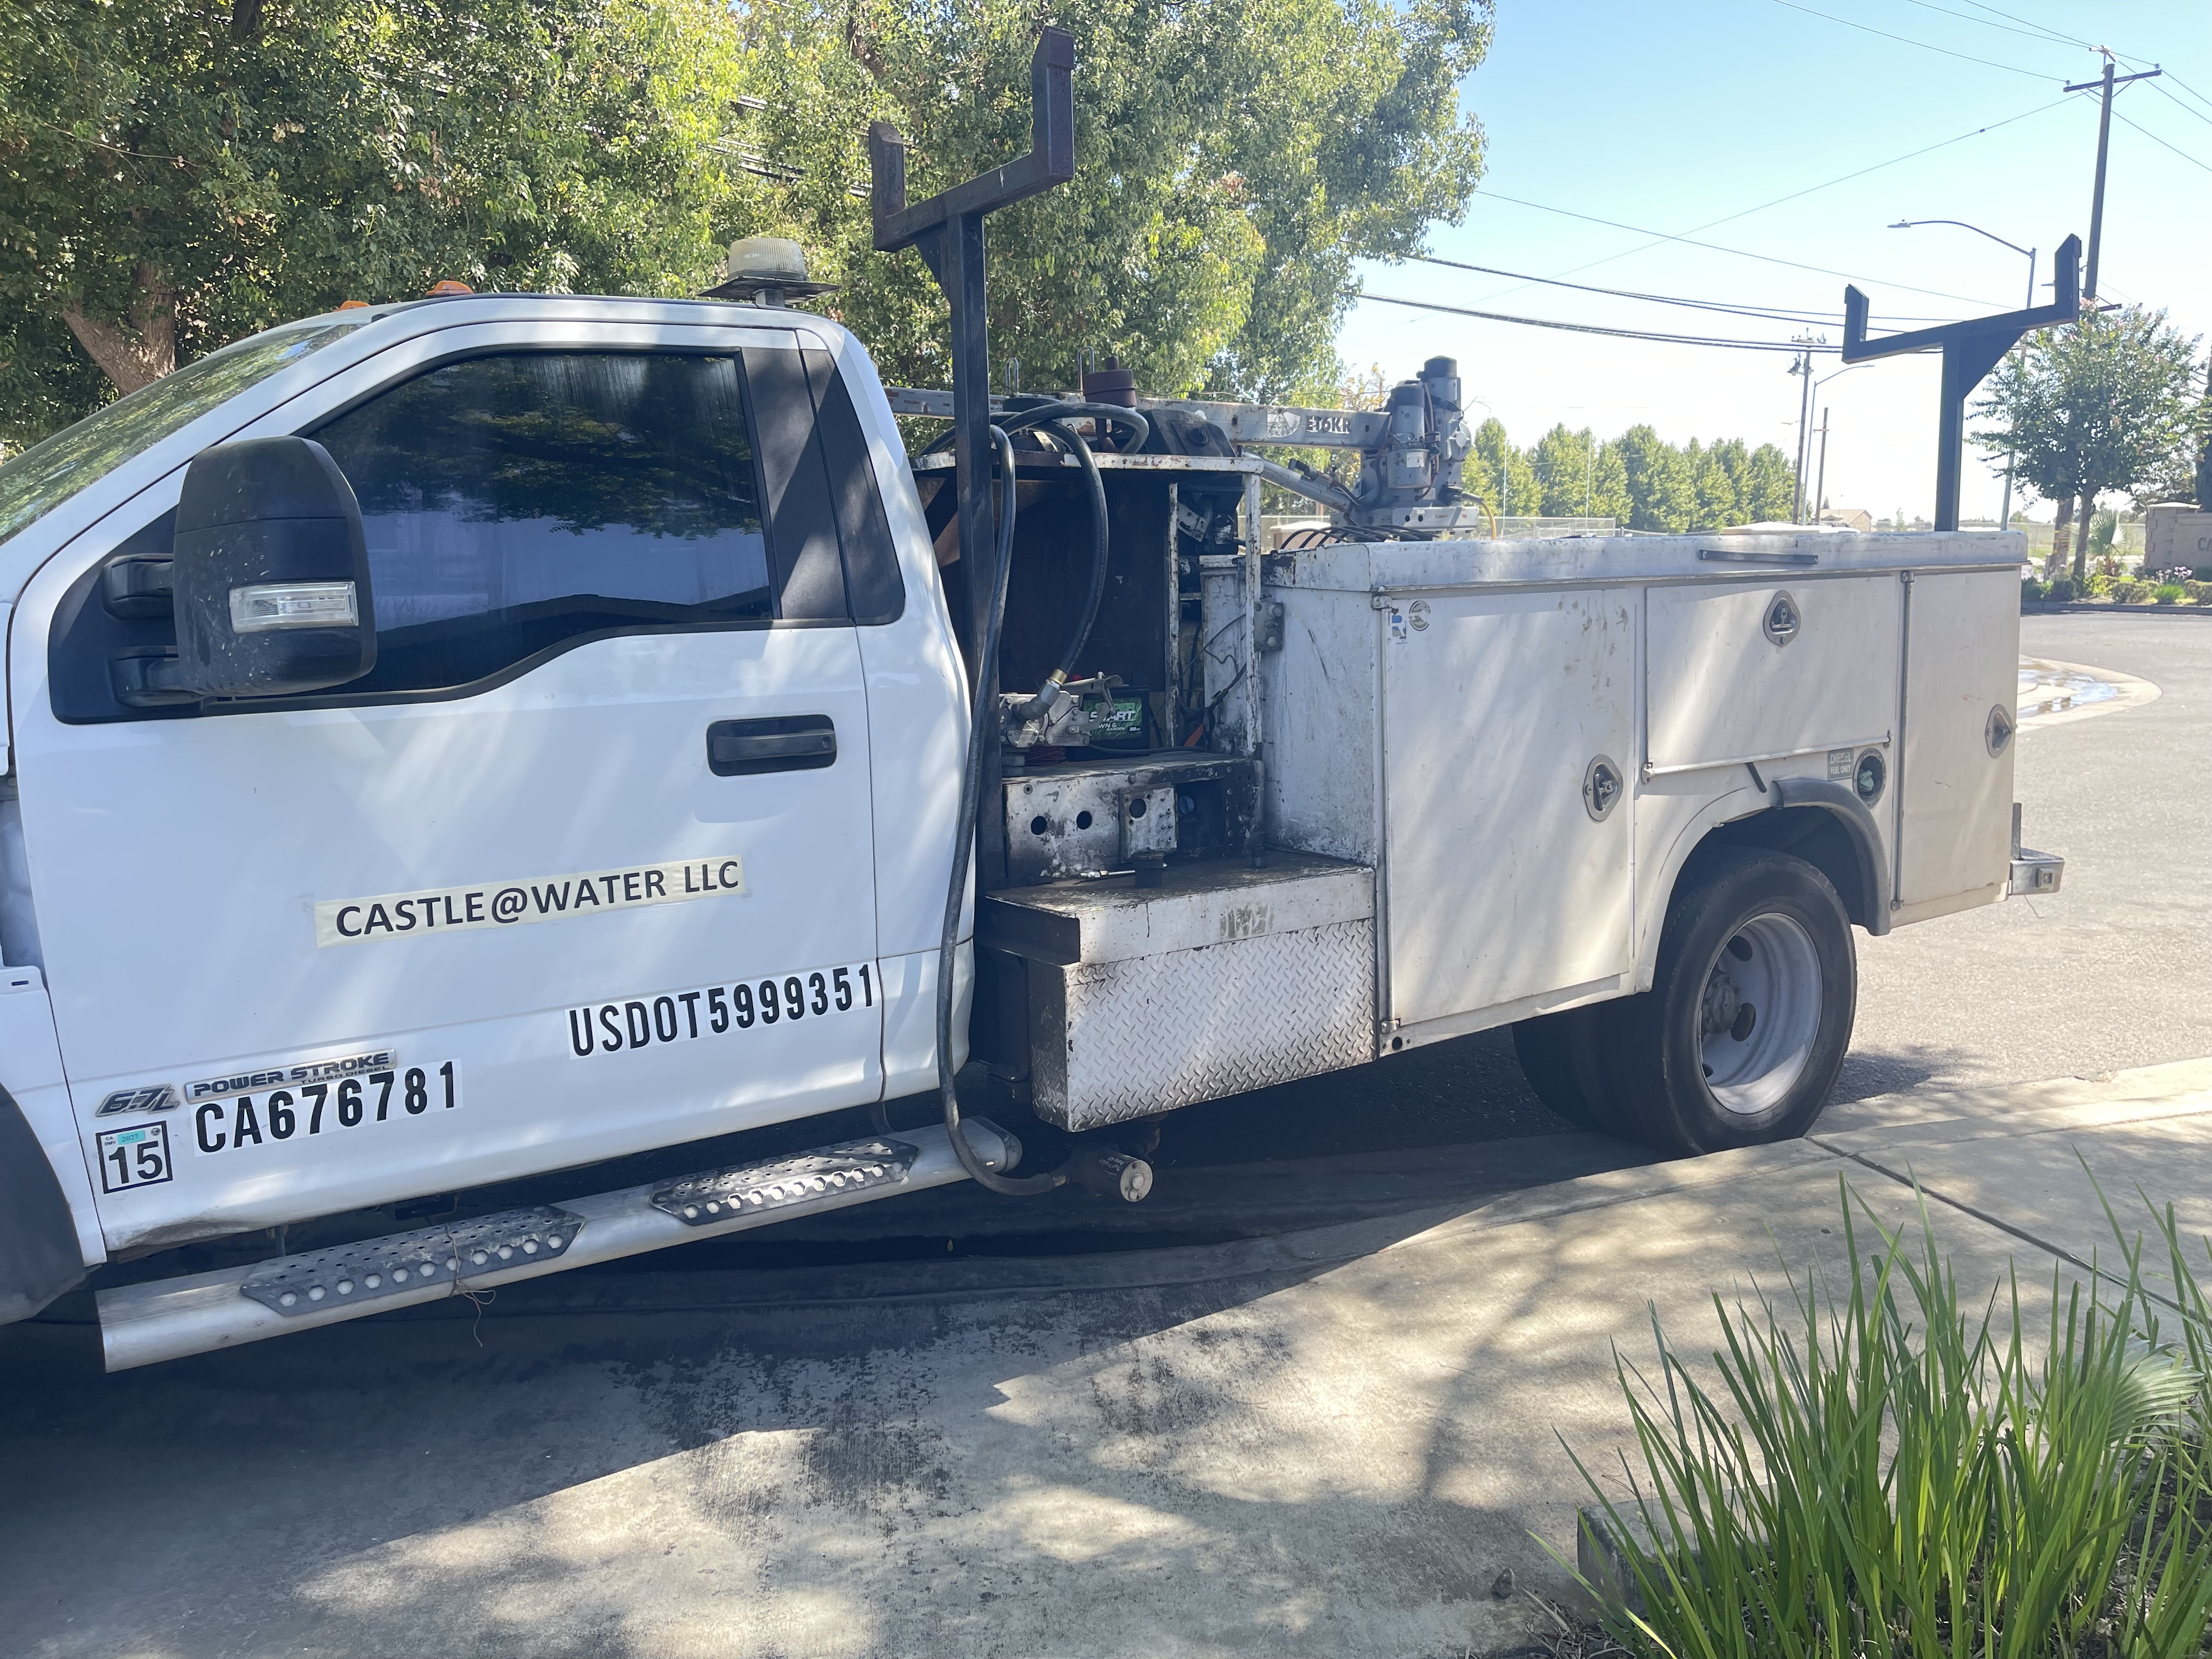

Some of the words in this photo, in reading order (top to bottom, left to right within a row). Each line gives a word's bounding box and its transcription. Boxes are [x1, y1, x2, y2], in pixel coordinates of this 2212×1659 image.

[1089, 710, 1136, 722] SART
[1095, 703, 1136, 711] SPER
[1830, 752, 1852, 764] DIESEL
[1830, 766, 1840, 775] FUEL
[1841, 765, 1851, 774] ONLY
[336, 870, 666, 936] CASTLE@WATER
[684, 861, 739, 893] LLC
[569, 964, 872, 1056] USDOT5999351
[194, 1071, 284, 1097] POWER
[290, 1052, 389, 1080] STROKE
[300, 1074, 342, 1084] TURBO
[345, 1066, 390, 1076] DIESEL
[195, 1061, 456, 1153] CA676781
[121, 1133, 139, 1142] 2027
[109, 1140, 163, 1184] 15
